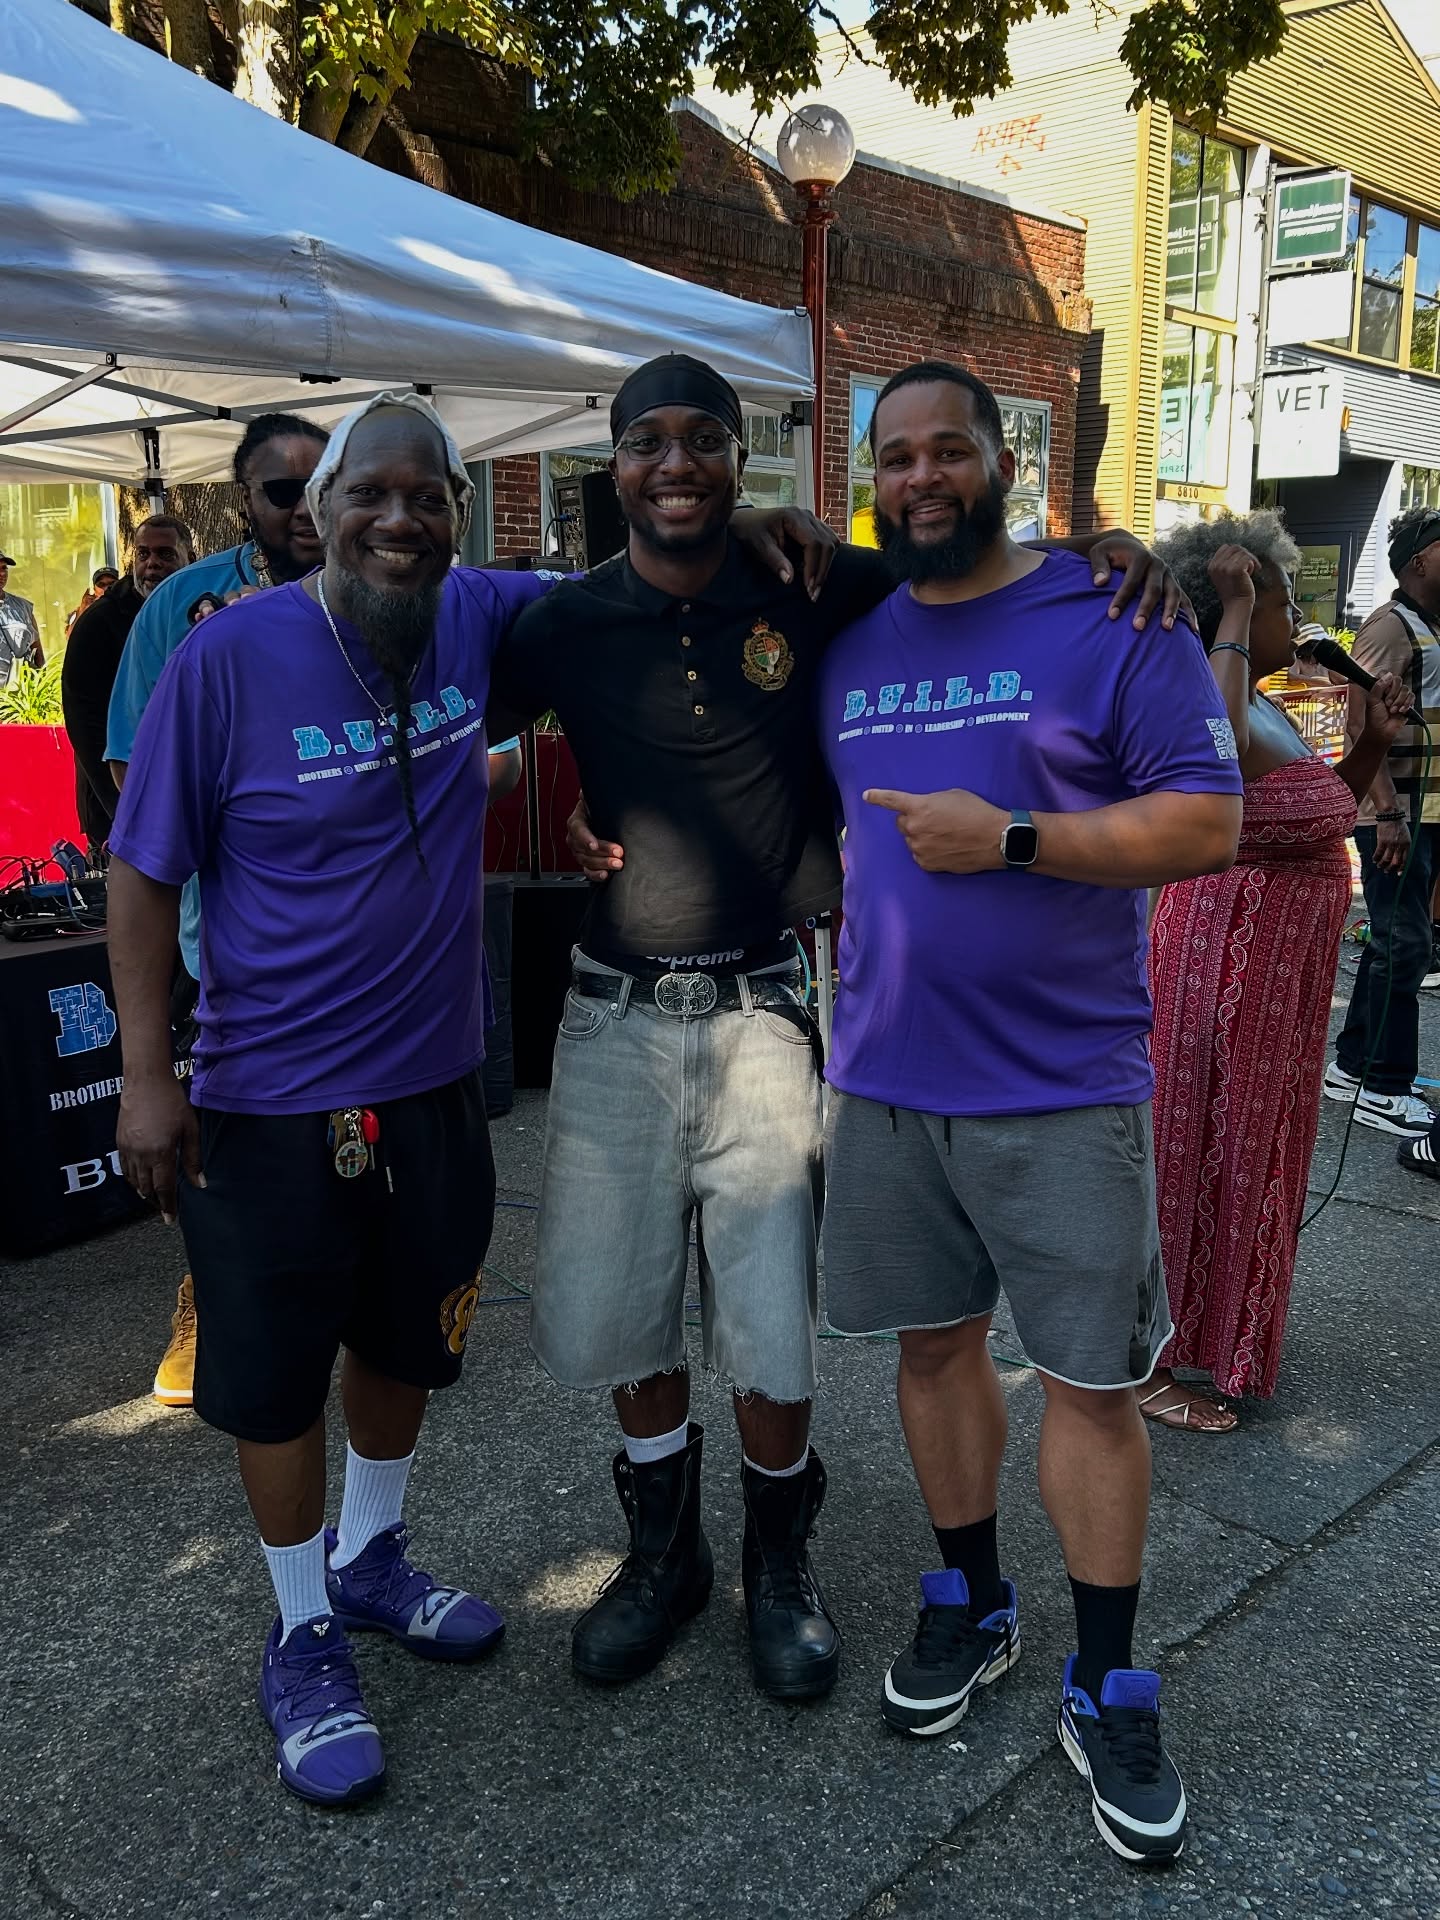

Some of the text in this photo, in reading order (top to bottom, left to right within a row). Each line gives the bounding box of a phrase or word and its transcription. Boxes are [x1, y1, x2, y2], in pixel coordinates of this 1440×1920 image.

[1277, 385, 1329, 412] VET
[293, 685, 476, 760] B.U..L.D.
[905, 724, 913, 733] IN
[925, 719, 966, 733] LEADERSHIP
[976, 712, 1030, 725] DEVELOPMENT
[297, 768, 343, 784] BROTHERS
[354, 760, 380, 773] UNITED
[646, 949, 745, 970] upreme
